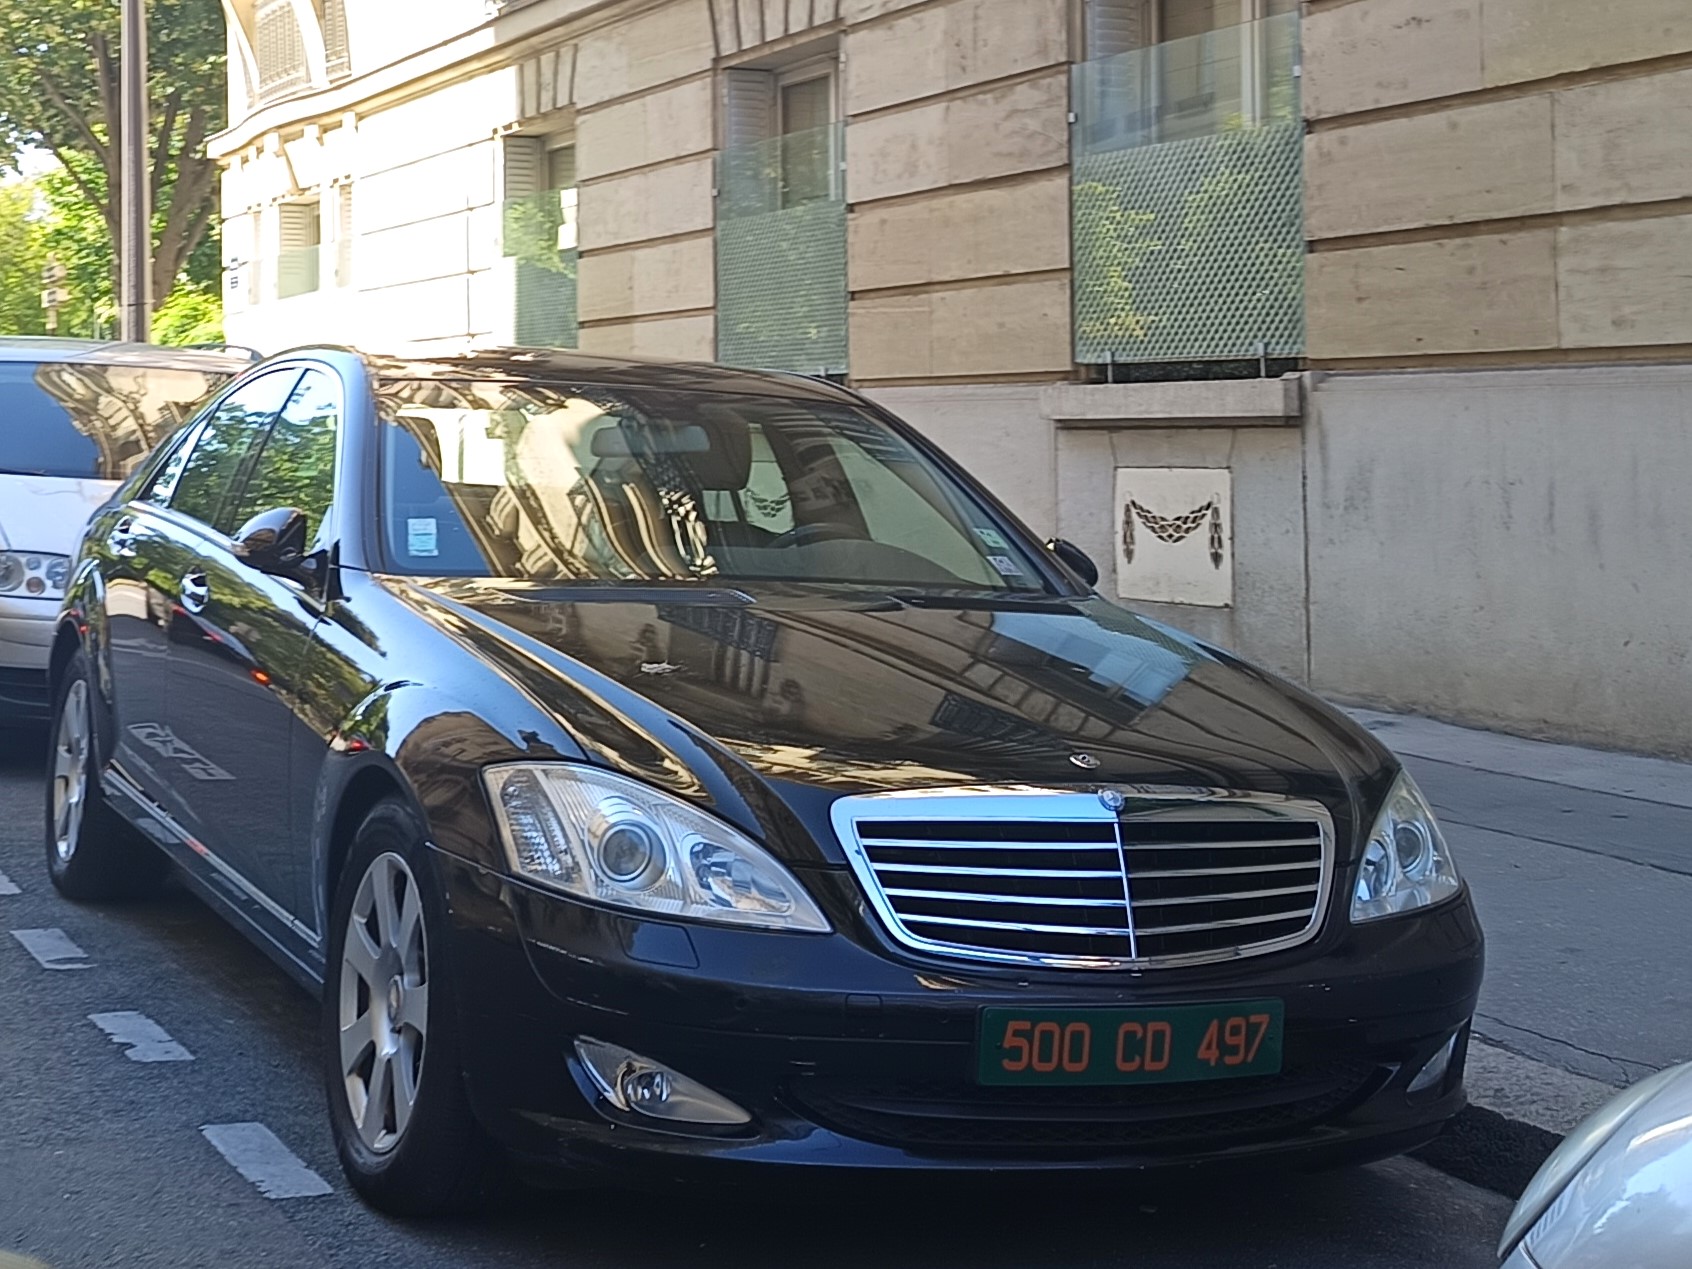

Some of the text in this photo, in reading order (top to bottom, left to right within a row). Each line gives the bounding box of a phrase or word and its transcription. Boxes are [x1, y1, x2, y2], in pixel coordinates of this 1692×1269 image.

[1002, 1014, 1270, 1072] 500 CD 497
